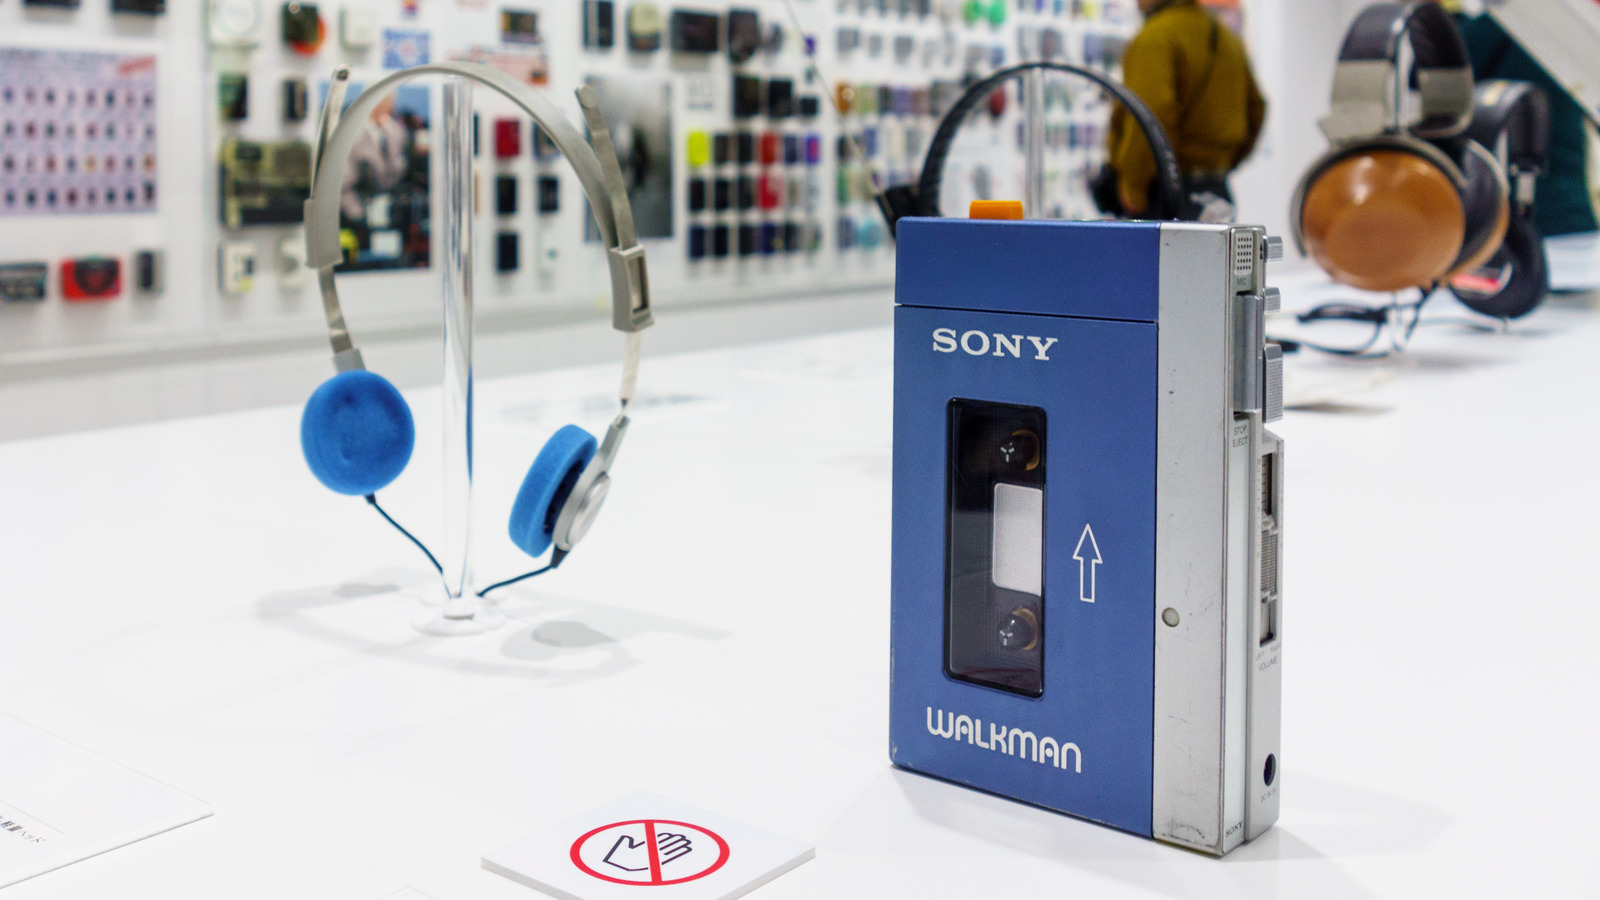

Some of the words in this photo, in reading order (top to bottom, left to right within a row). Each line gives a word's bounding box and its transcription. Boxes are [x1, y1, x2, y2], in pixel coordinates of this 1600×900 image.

[932, 327, 1059, 361] SONY
[1233, 424, 1248, 436] STOP
[1232, 436, 1248, 448] EJECT
[1258, 656, 1278, 672] VOLUME
[926, 706, 1082, 774] WALKMAN
[1225, 820, 1244, 838] SONY
